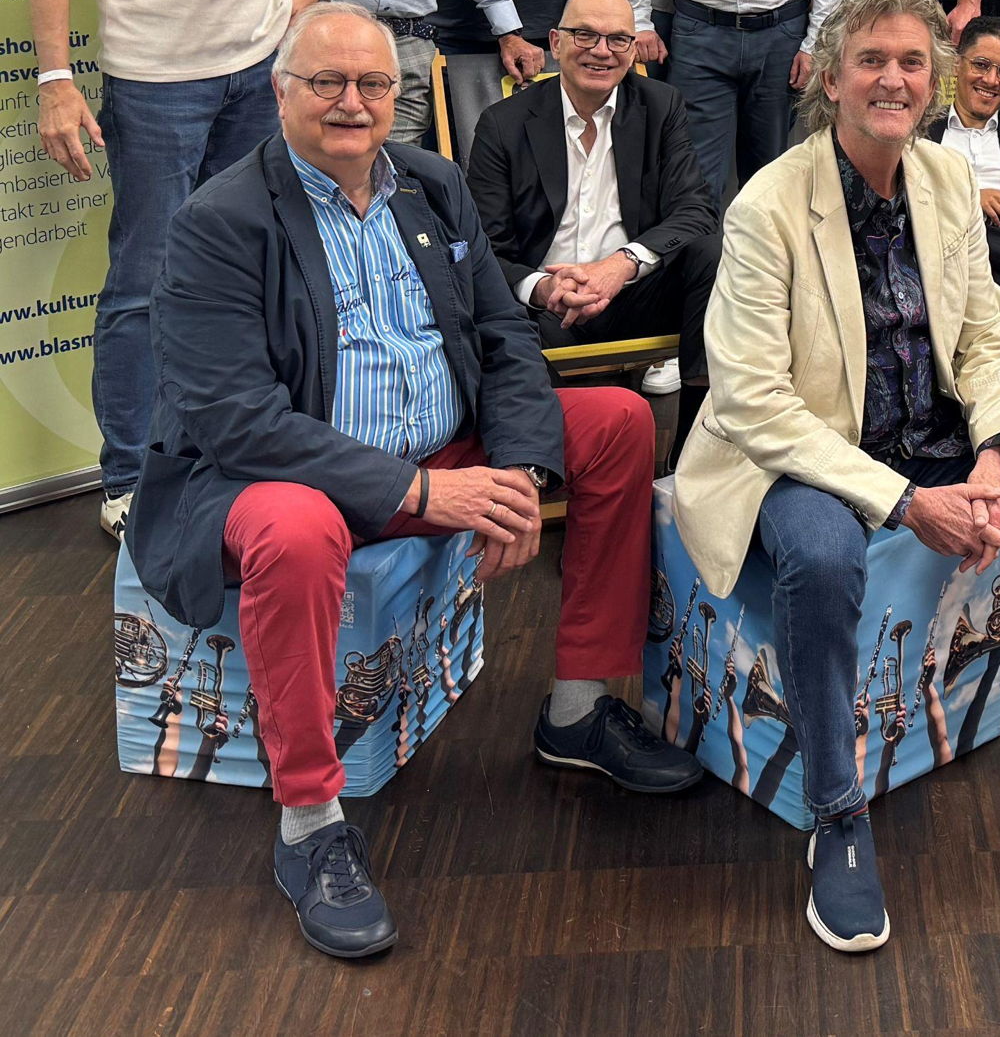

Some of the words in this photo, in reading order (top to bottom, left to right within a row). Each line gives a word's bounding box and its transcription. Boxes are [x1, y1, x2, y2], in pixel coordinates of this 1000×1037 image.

[40, 200, 60, 215] zu
[66, 192, 109, 210] einer
[0, 222, 87, 252] endarbeit
